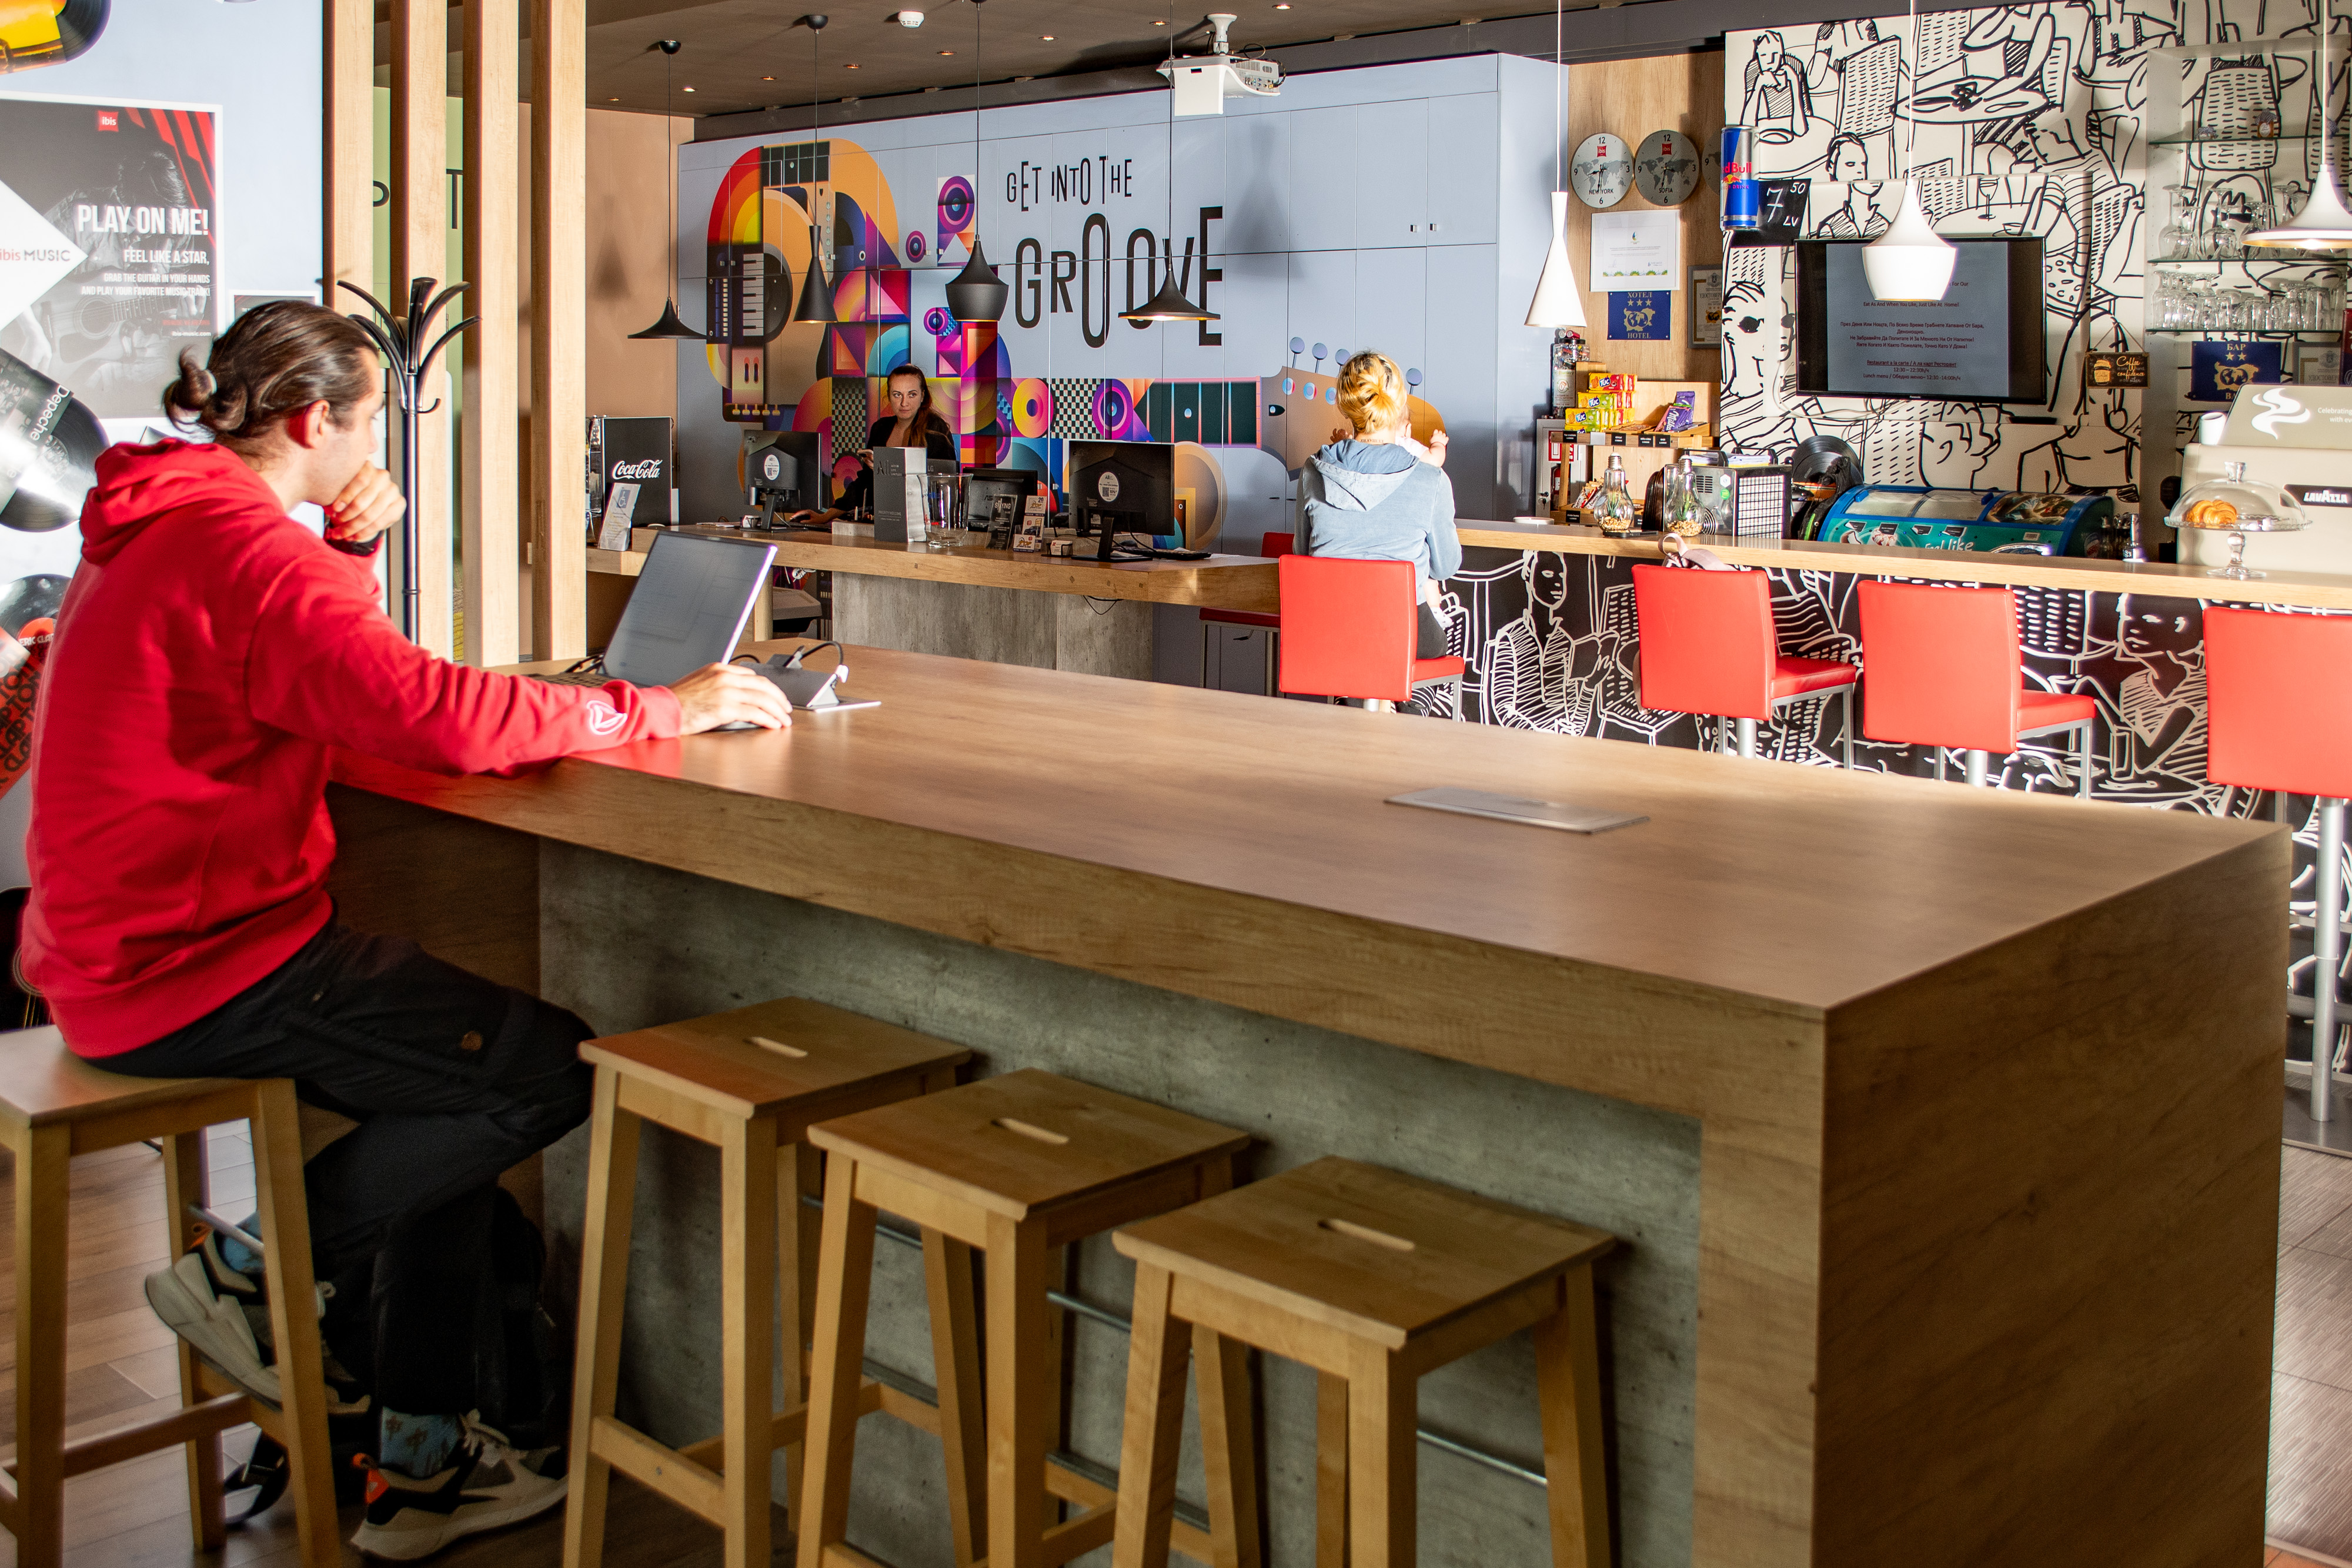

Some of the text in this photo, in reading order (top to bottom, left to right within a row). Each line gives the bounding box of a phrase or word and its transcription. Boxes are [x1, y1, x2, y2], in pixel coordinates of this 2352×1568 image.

[102, 116, 117, 126] ibis
[1626, 165, 1630, 173] 3
[1638, 165, 1642, 173] 9
[1006, 156, 1132, 212] GET INTO THE
[1766, 182, 1806, 223] 7 50
[78, 205, 209, 236] PLAY ON ME!
[0, 249, 71, 262] ibis MUSIC
[124, 249, 210, 265] FEEL LIKE A STAR,
[104, 273, 211, 283] GRAB THE GUITAR IN YOUR HANDS
[1015, 206, 1223, 349] GROOVE
[81, 286, 96, 295] AND
[97, 286, 113, 295] PLAY
[115, 286, 133, 295] YOUR
[134, 287, 165, 296] FAVORITE
[166, 287, 186, 296] MUSIC
[30, 384, 70, 441] Depeche
[2303, 490, 2347, 504] LAVAZZA
[19, 637, 36, 647] ERIC
